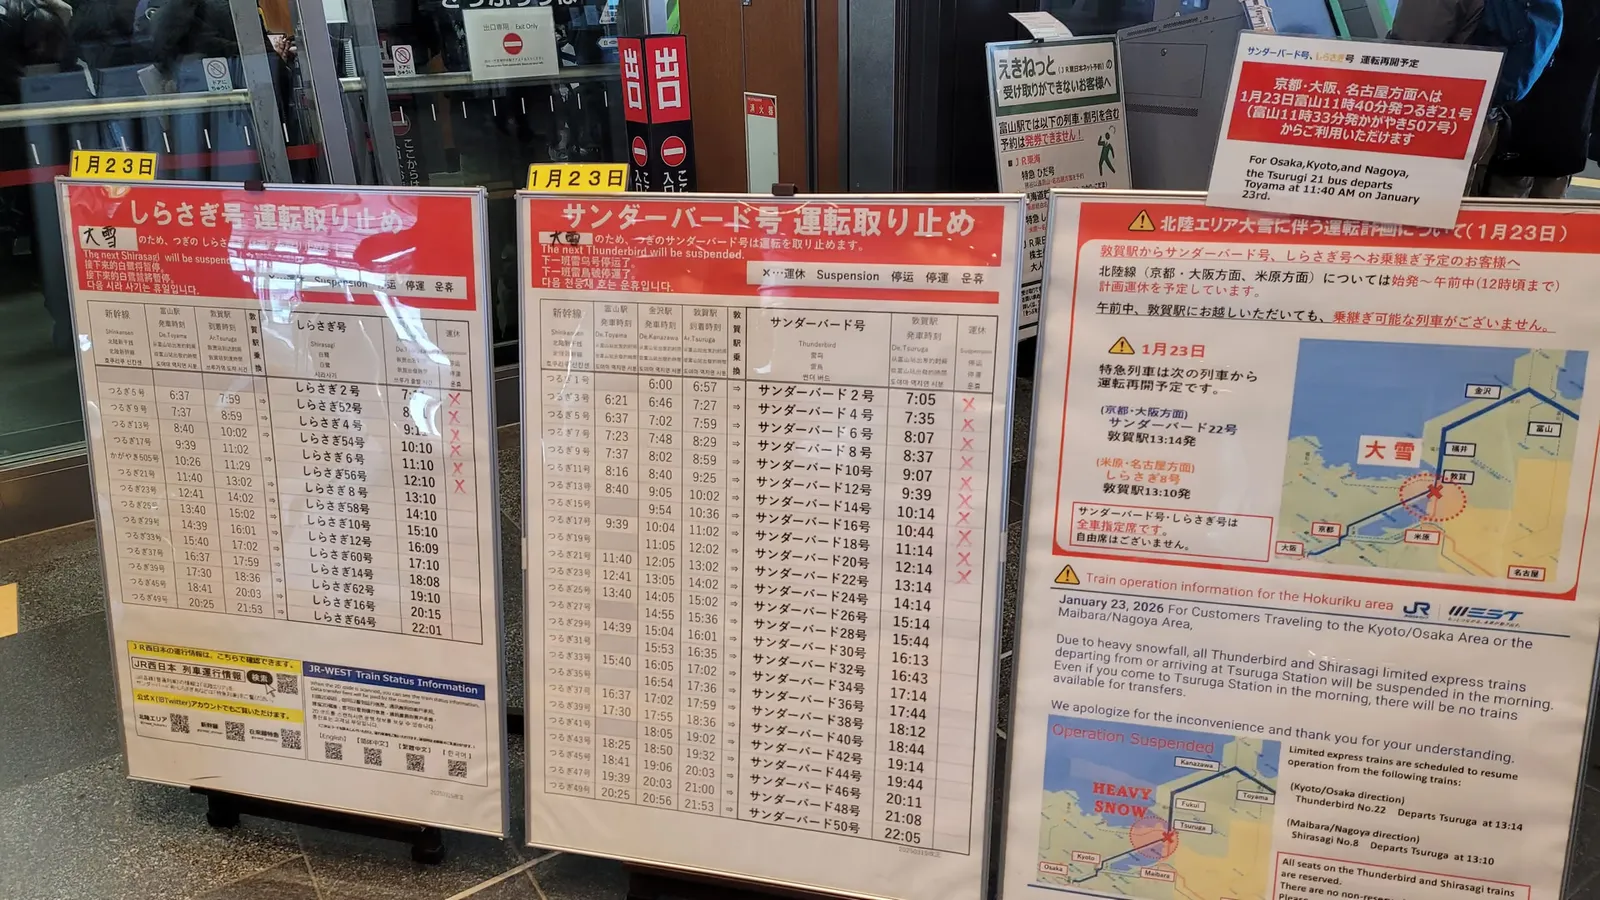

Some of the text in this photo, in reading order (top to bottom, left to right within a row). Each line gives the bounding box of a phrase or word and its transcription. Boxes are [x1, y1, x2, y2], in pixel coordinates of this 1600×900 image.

[624, 48, 642, 110] 出口
[655, 47, 681, 110] 出口
[1273, 77, 1443, 101] 京都・大阪、名古屋方面へは
[1240, 91, 1473, 121] 1月23日富山11時40分発つるぎ21号
[1280, 122, 1415, 146] からご利用いただけます
[74, 155, 153, 176] 1月23日
[1249, 155, 1267, 166] For
[1365, 164, 1409, 179] Nagoya,
[532, 168, 624, 188] 1月23日
[1247, 168, 1393, 190] the Tsurugi 21 bus departs
[1242, 190, 1271, 201] 23rd.
[1244, 180, 1420, 205] Toyama at 11:40 AM on January
[131, 200, 403, 235] しらさぎ号 運転取り止め
[563, 203, 975, 237] サンダーバード号 運転取り止め
[541, 244, 745, 260] The next Thunderbird will be suspended.
[817, 269, 879, 282] Suspension
[891, 271, 914, 283] 停运
[925, 271, 949, 284] 停運
[1099, 280, 1260, 298] 計画運休を予定しています。
[297, 320, 347, 333] しらさぎ号
[770, 316, 866, 332] サンダーバード号
[1142, 342, 1206, 358] 1月23日
[1099, 363, 1258, 383] 特急列車は次の列車から
[1097, 377, 1219, 395] 運転再開予定です。
[1109, 417, 1238, 435] サンダーバード22号
[1107, 430, 1196, 447] 敦賀駅13:14発
[1365, 440, 1415, 462] 大雪
[756, 458, 933, 483] サンダーバード10号 9:07
[1106, 470, 1181, 485] しらさぎ8号
[118, 468, 155, 478] つるぎ21号
[177, 472, 203, 483] 11:40
[226, 476, 252, 487] 13:02
[405, 492, 436, 505] 13:10
[1103, 482, 1191, 499] 敦賀駅13:10発
[1077, 518, 1167, 536] 全車指定席です。
[1076, 531, 1190, 551] 自由席はございません。
[603, 552, 932, 594] 11:40 12:05 13:02 サンダーバード22号 13:14
[1086, 572, 1394, 611] Train operation information for the Hokuriku area
[189, 598, 215, 609] 20:25
[237, 603, 263, 614] 21:53
[314, 611, 377, 628] しらさぎ64号
[412, 623, 442, 636] 22:01
[1058, 607, 1193, 631] Maibara/Nagoya Area,
[1403, 601, 1431, 616] JR
[1059, 594, 1533, 650] January 23, 2026 For Customers Traveling to the Kyoto/Osaka Area or the
[309, 665, 478, 694] JR-WEST Train Status Information
[1052, 723, 1215, 754] Operation Suspended
[1180, 759, 1214, 770] Kanazawa
[1093, 781, 1153, 801] HEAVY
[601, 787, 921, 844] 20:25 20:56 21:53 サンダーバード50号 22:05
[1094, 799, 1148, 818] SNOW
[1295, 794, 1523, 832] Thunderbird No.22 Departs Tsuruga at 13:14
[1291, 830, 1495, 866] Shirasagi No.8 Departs Tsuruga at 13:10
[1143, 869, 1171, 879] Maibara
